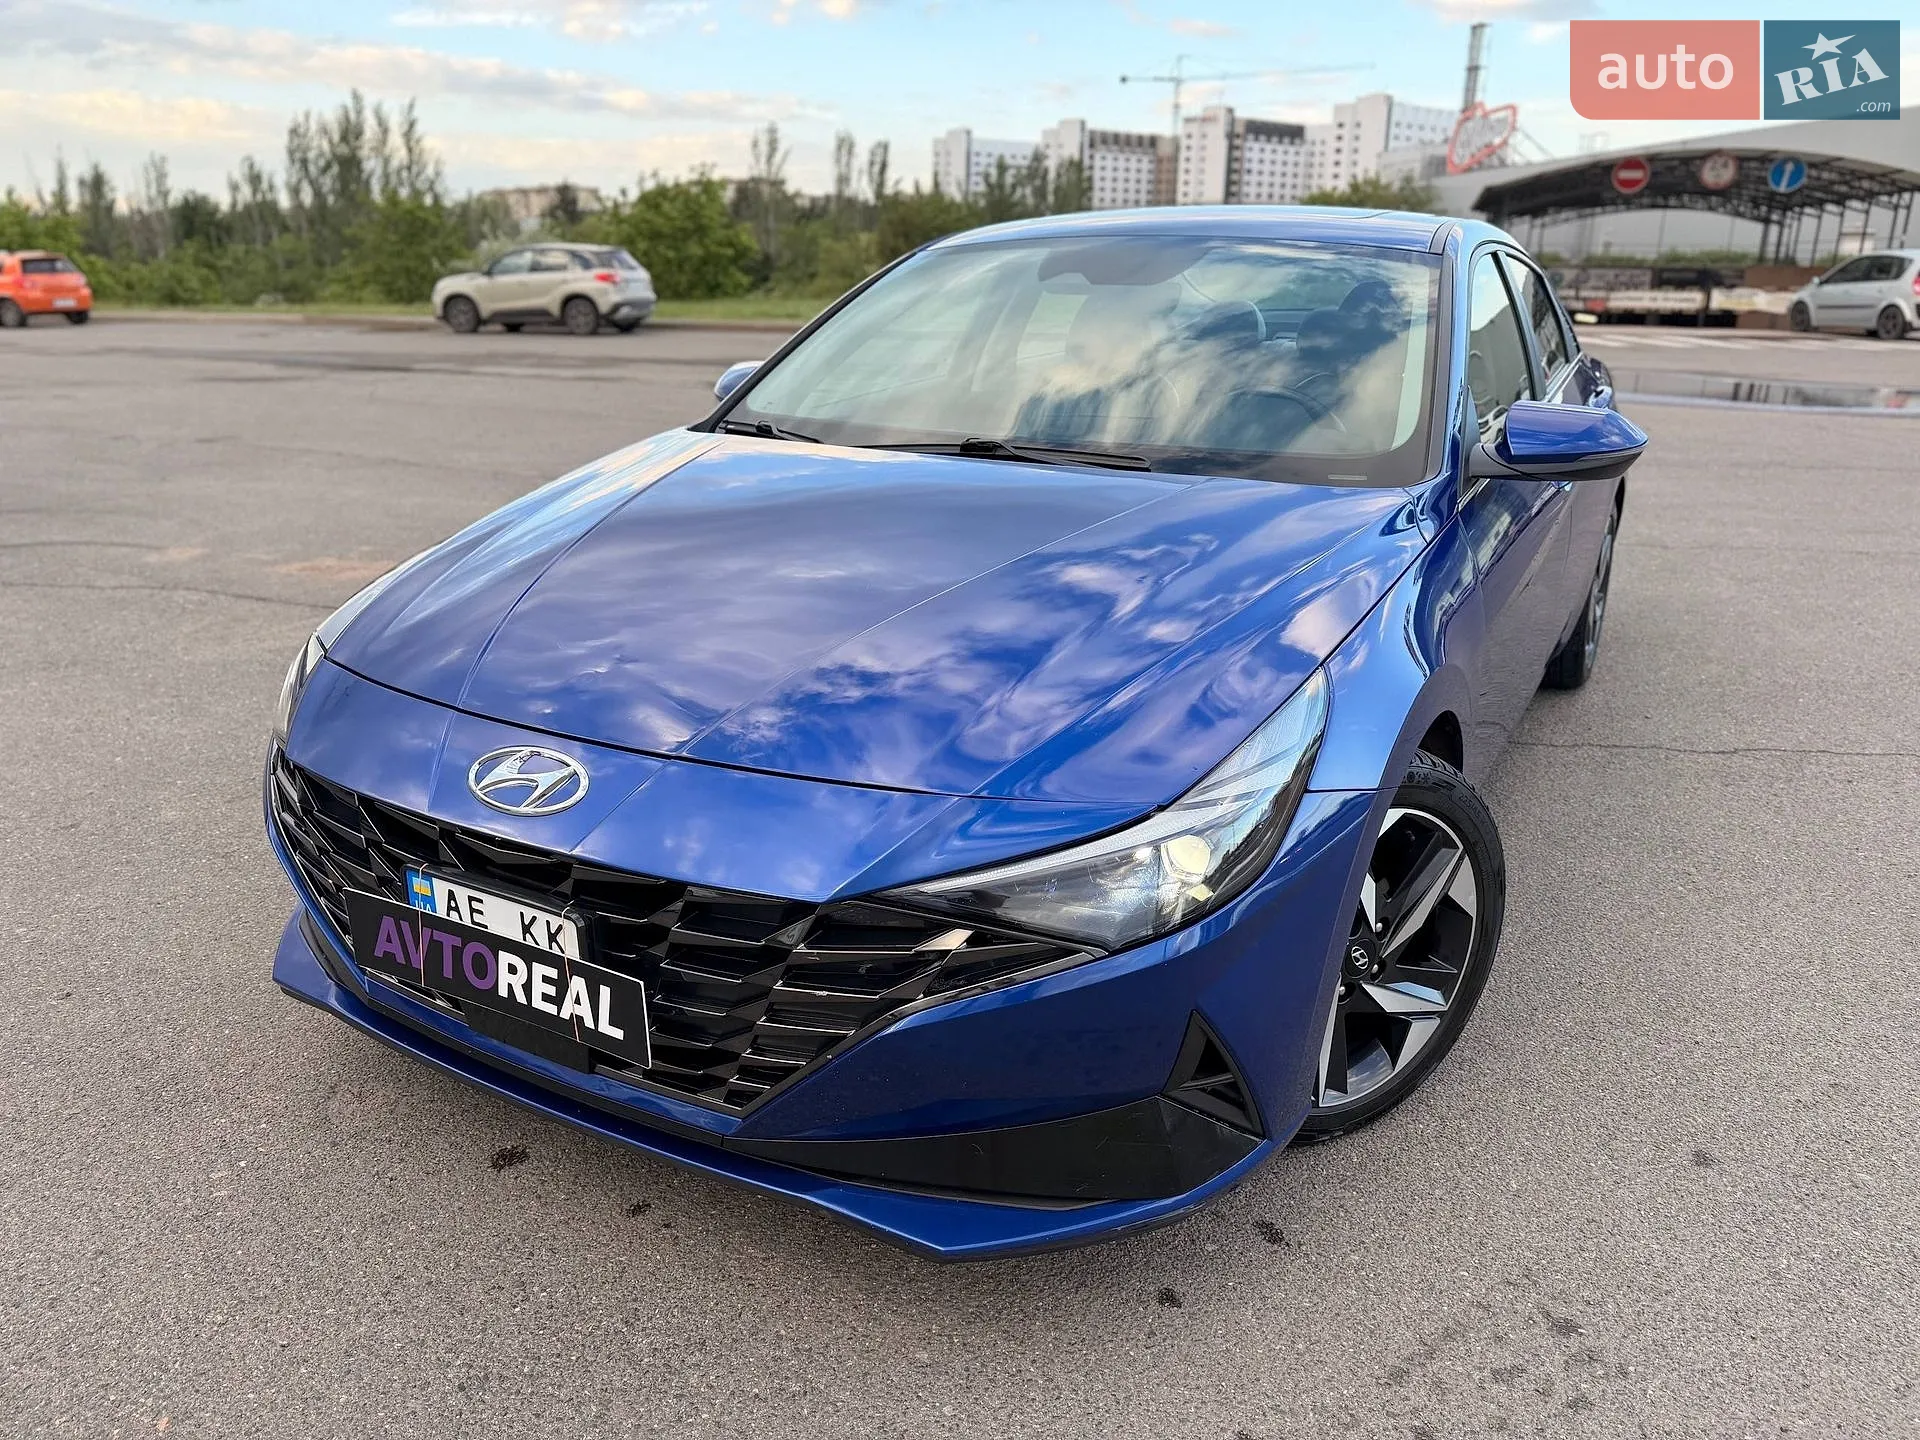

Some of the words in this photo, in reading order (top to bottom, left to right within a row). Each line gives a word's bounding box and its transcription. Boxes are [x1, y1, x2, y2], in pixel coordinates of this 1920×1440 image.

[446, 888, 489, 930] AE
[520, 911, 565, 954] KK
[374, 915, 624, 1040] AVTOREAL
